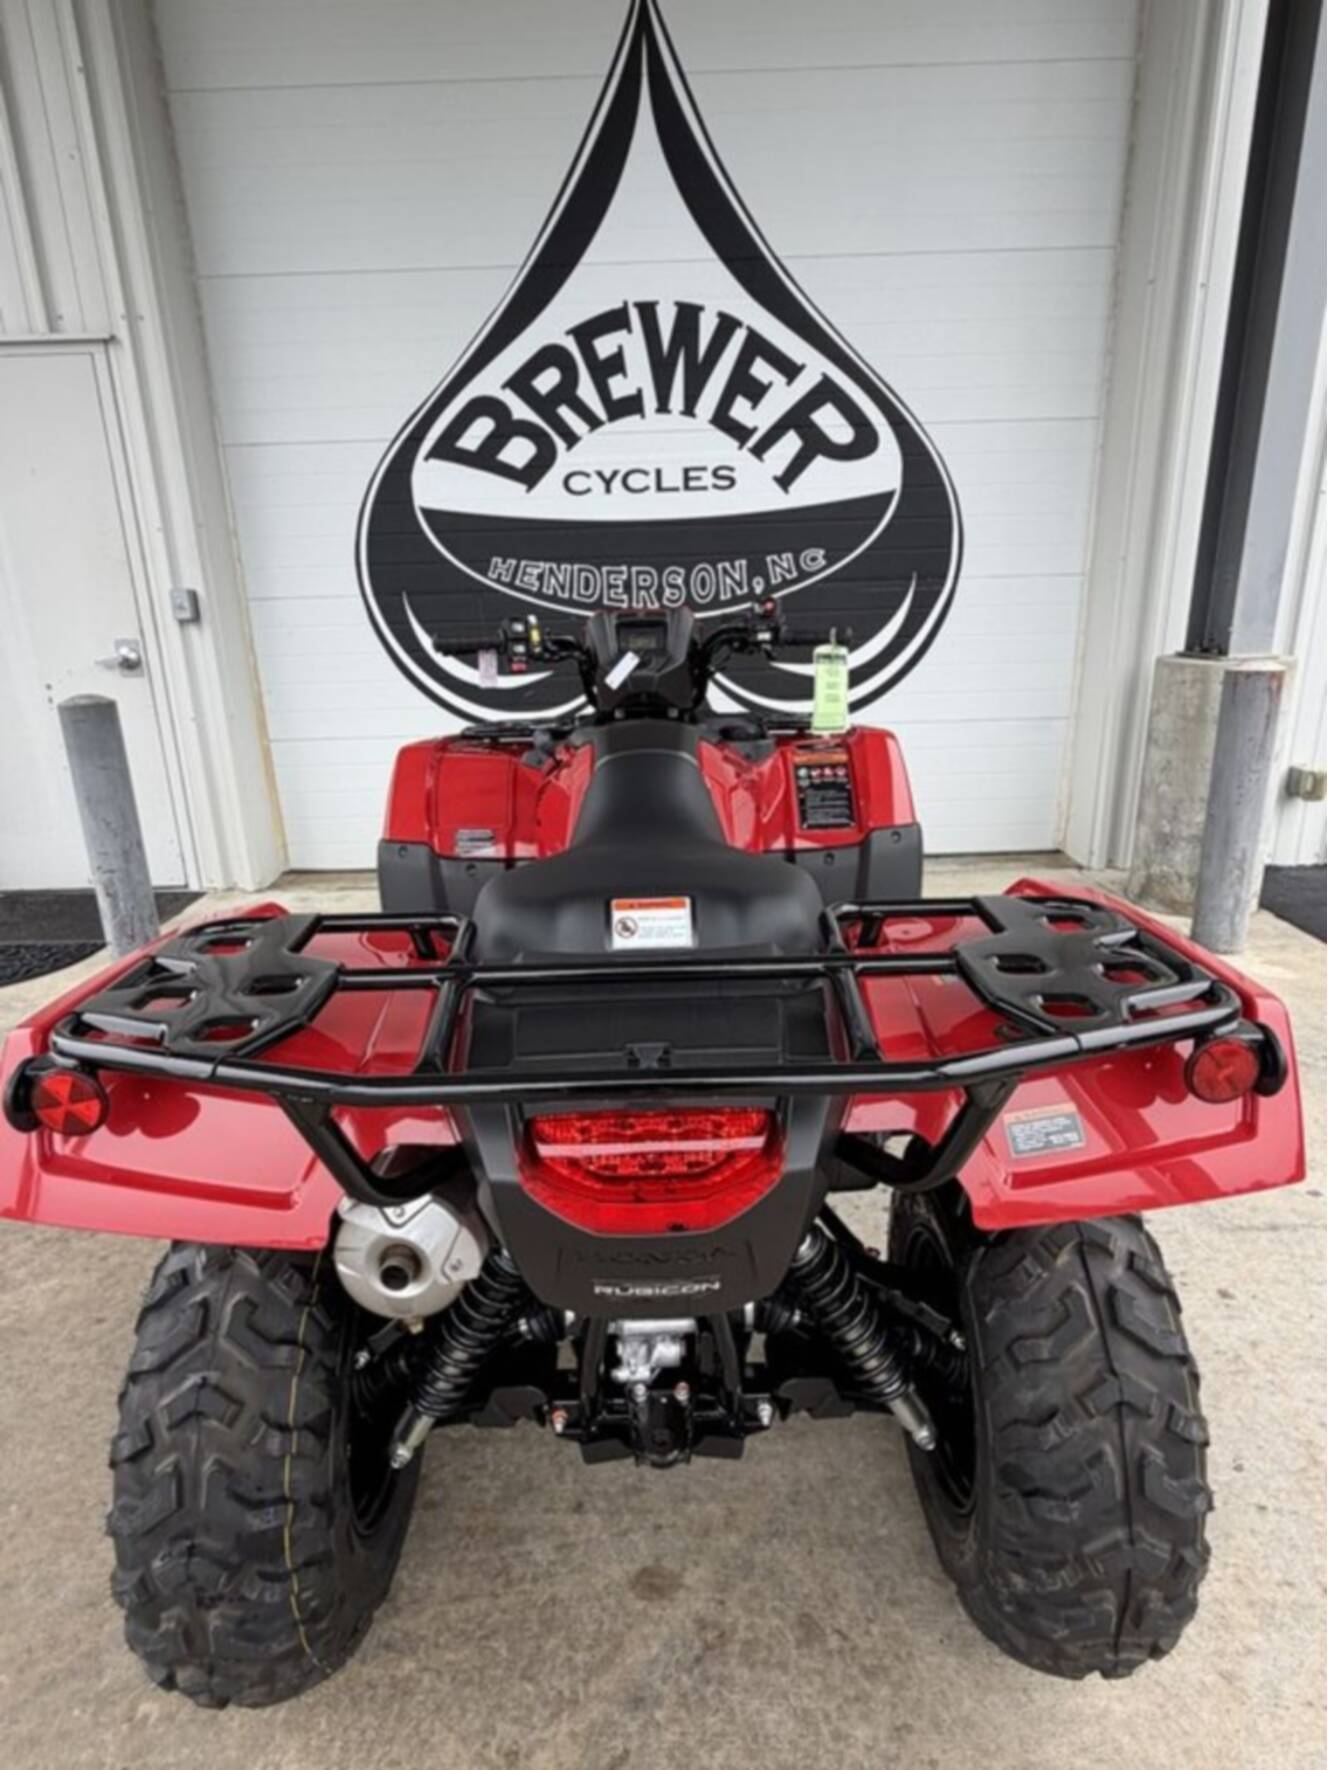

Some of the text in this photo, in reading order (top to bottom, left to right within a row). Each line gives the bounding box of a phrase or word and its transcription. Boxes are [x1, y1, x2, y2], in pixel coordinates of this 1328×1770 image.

[423, 301, 880, 494] BREWER
[563, 466, 737, 496] CYCLES
[593, 1280, 721, 1297] RUBICON
